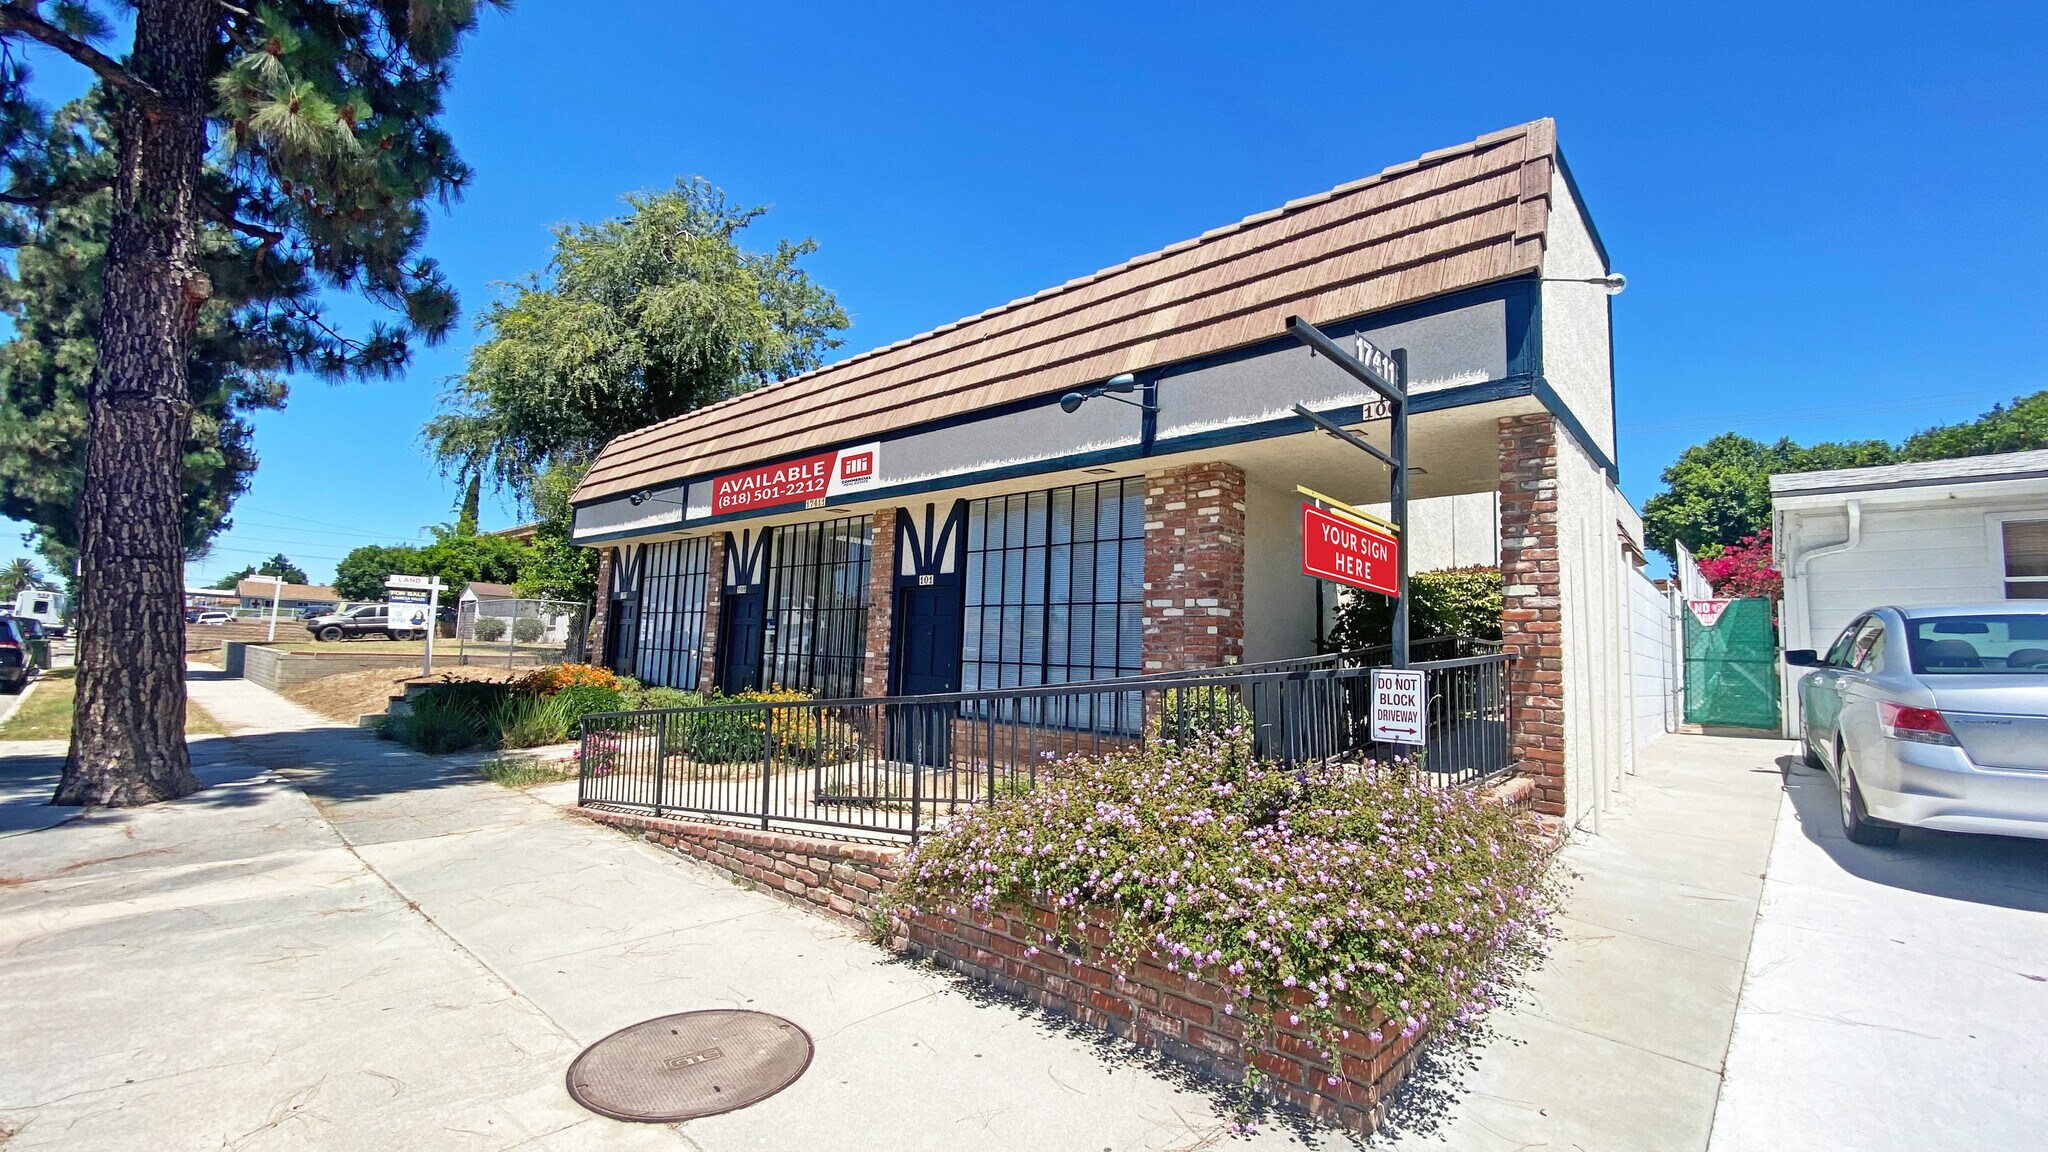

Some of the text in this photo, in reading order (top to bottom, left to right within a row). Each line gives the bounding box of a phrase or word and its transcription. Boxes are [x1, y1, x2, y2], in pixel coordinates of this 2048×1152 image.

[1356, 336, 1395, 385] 17411
[845, 457, 868, 475] illi
[719, 460, 825, 495] AVAILABLE
[841, 476, 872, 484] COMMERCIAL
[718, 477, 825, 509] (818) 501-2212
[1321, 522, 1388, 562] YOUR SIGN
[1335, 551, 1372, 580] HERE
[920, 575, 933, 585] 101
[1694, 602, 1711, 614] NO
[1377, 677, 1418, 691] DO NOT
[1379, 693, 1416, 707] BLOCK
[1377, 708, 1418, 723] DRIVEWAY
